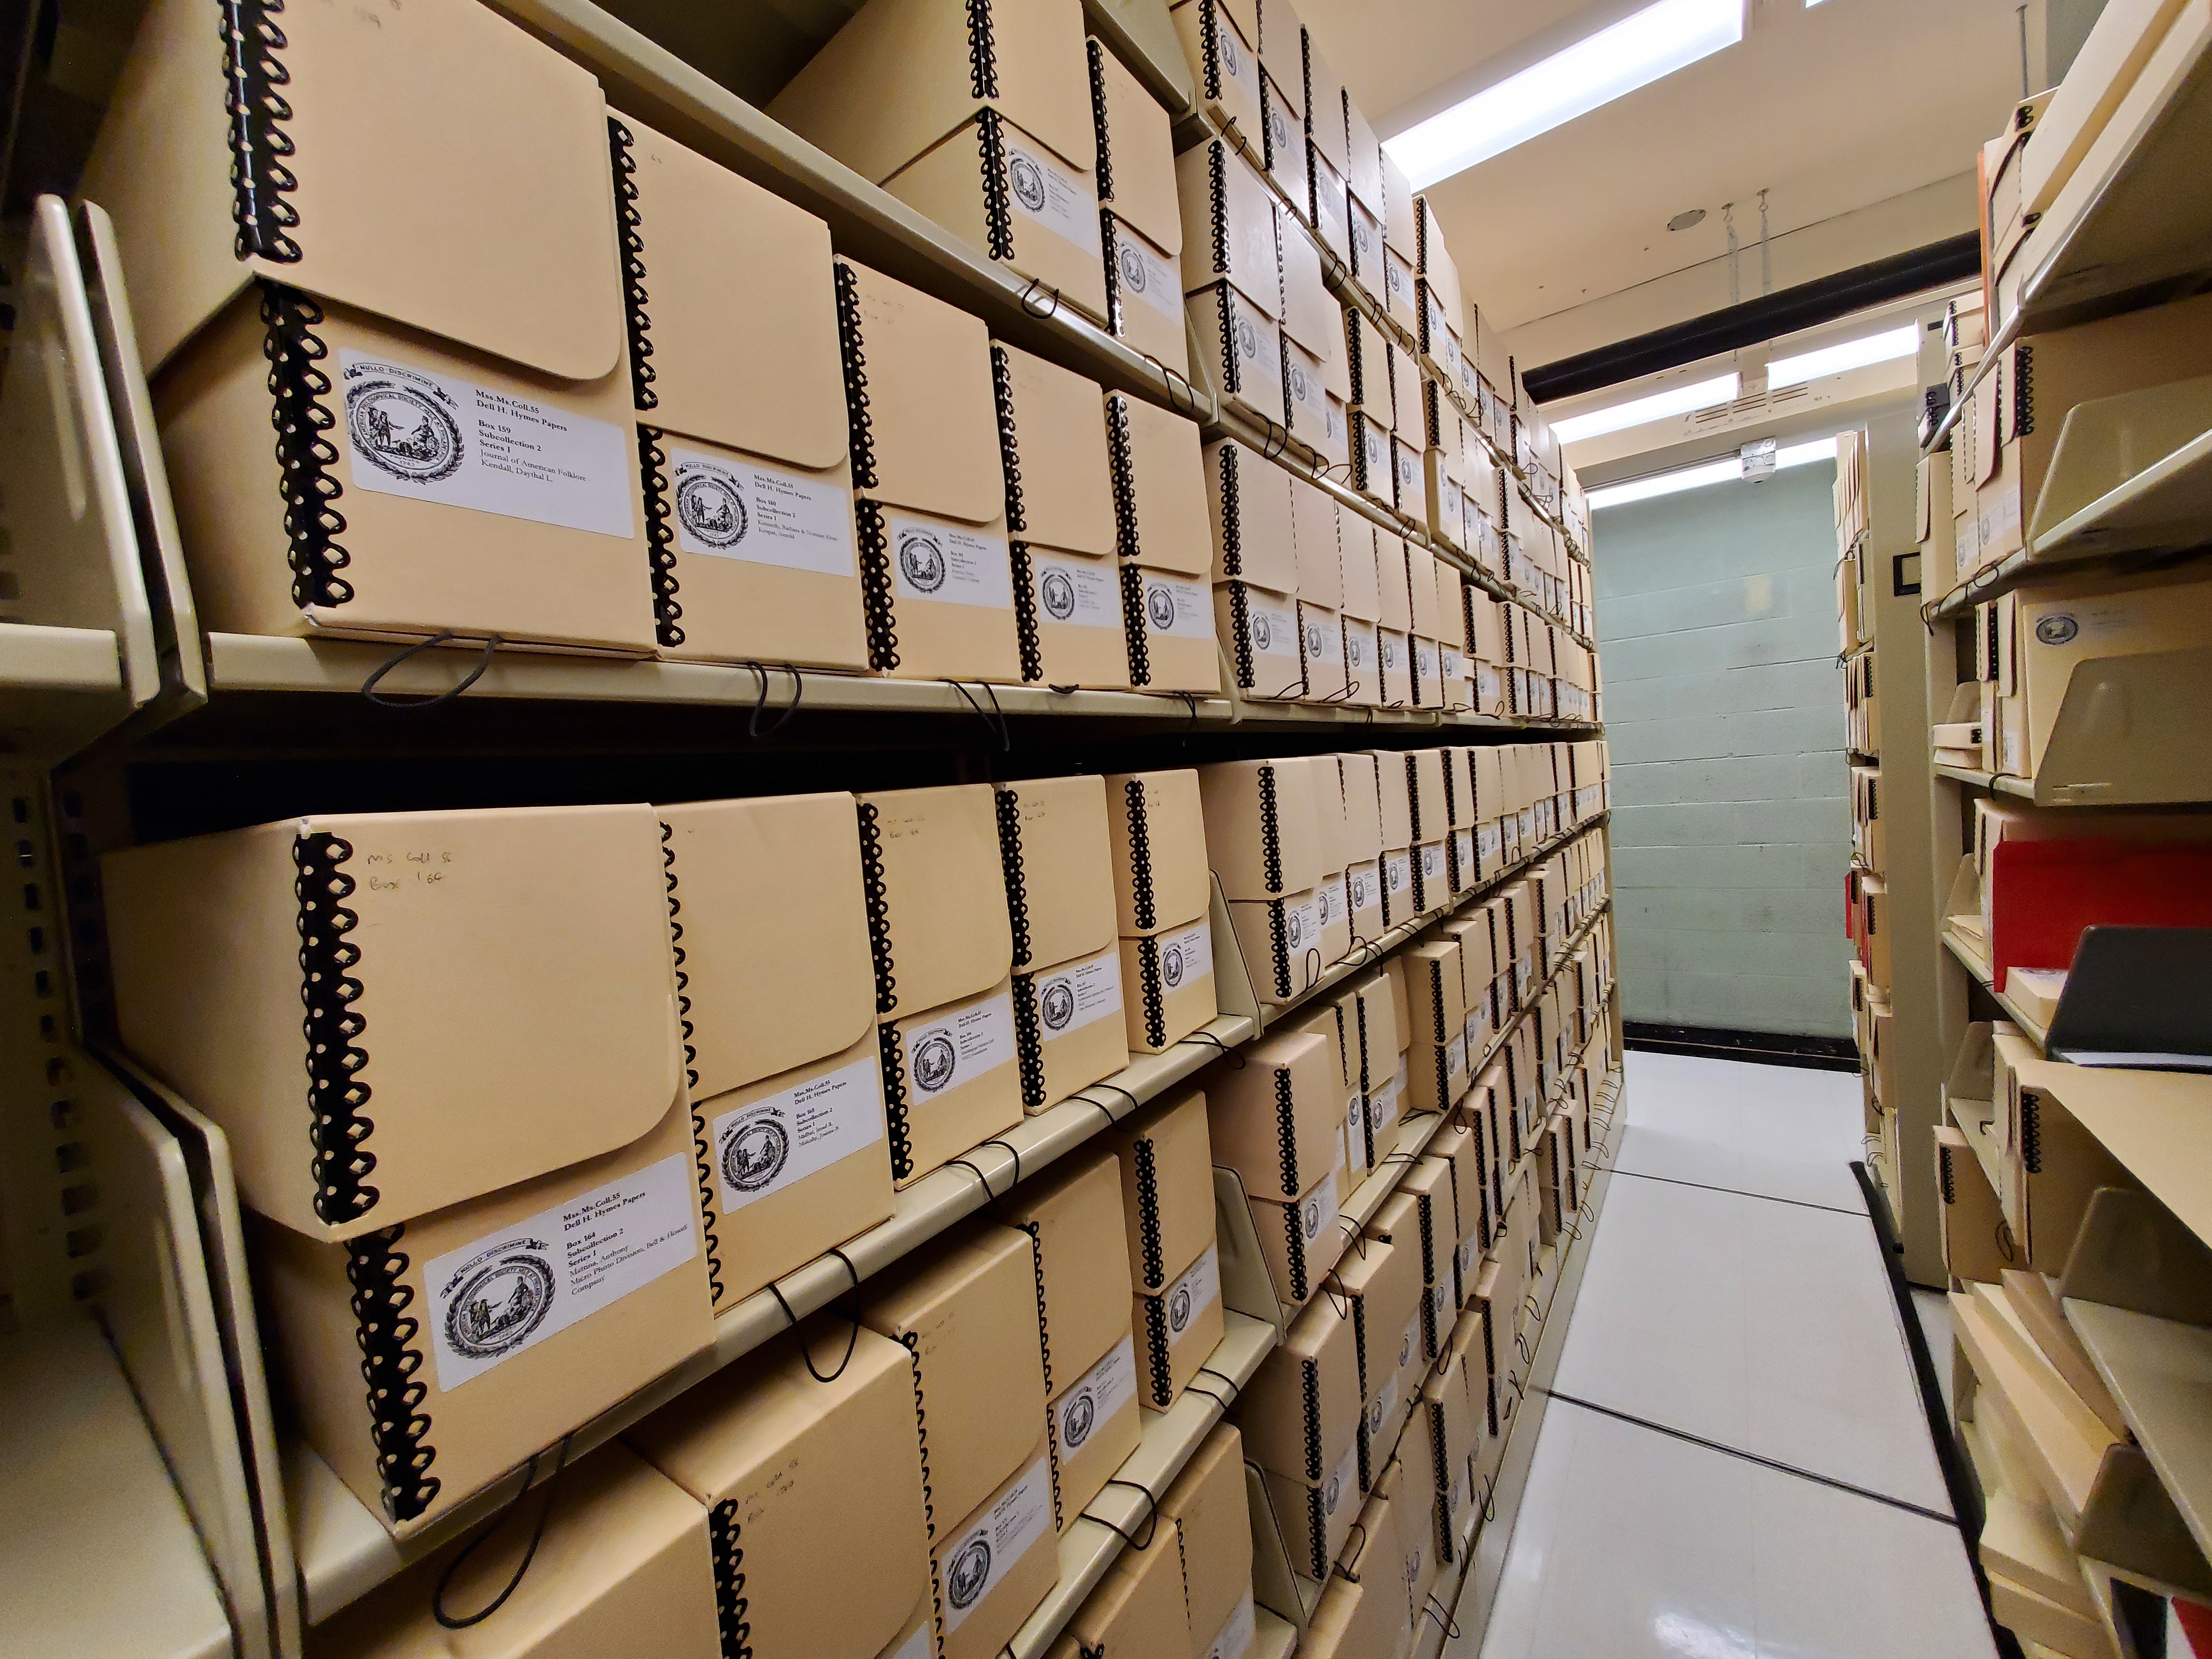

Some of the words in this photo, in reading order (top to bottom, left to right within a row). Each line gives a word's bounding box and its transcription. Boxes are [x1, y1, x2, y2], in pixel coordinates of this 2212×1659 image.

[475, 389, 540, 414] Mss.Ms.Coll.55
[477, 399, 495, 410] Dell
[497, 406, 508, 414] H.
[511, 409, 540, 424] Hymes
[542, 419, 567, 432] Papers
[478, 419, 495, 430] Box
[498, 425, 511, 434] 159
[479, 429, 535, 450] Subcollection
[480, 439, 504, 451] Series
[480, 449, 509, 462] Journal
[522, 460, 556, 474] American
[558, 469, 587, 481] Folklore
[516, 468, 544, 480] Daythal
[795, 492, 811, 500] Papers
[757, 505, 791, 517] Subcollection
[757, 512, 773, 520] Series
[814, 1088, 830, 1097] Hymes
[796, 1110, 829, 1126] Subcollection
[797, 1125, 812, 1133] Series
[563, 1192, 621, 1222] Mss.Ms.Coll.55
[564, 1219, 580, 1231] Dell
[583, 1215, 593, 1223] H.
[595, 1203, 621, 1218] Hymes
[623, 1192, 646, 1206] Papers
[566, 1239, 582, 1250] Box
[584, 1232, 596, 1242] 164
[567, 1232, 617, 1259] Subcollection
[568, 1255, 591, 1267] Series
[601, 1245, 629, 1262] Anthony
[594, 1262, 614, 1274] Photo
